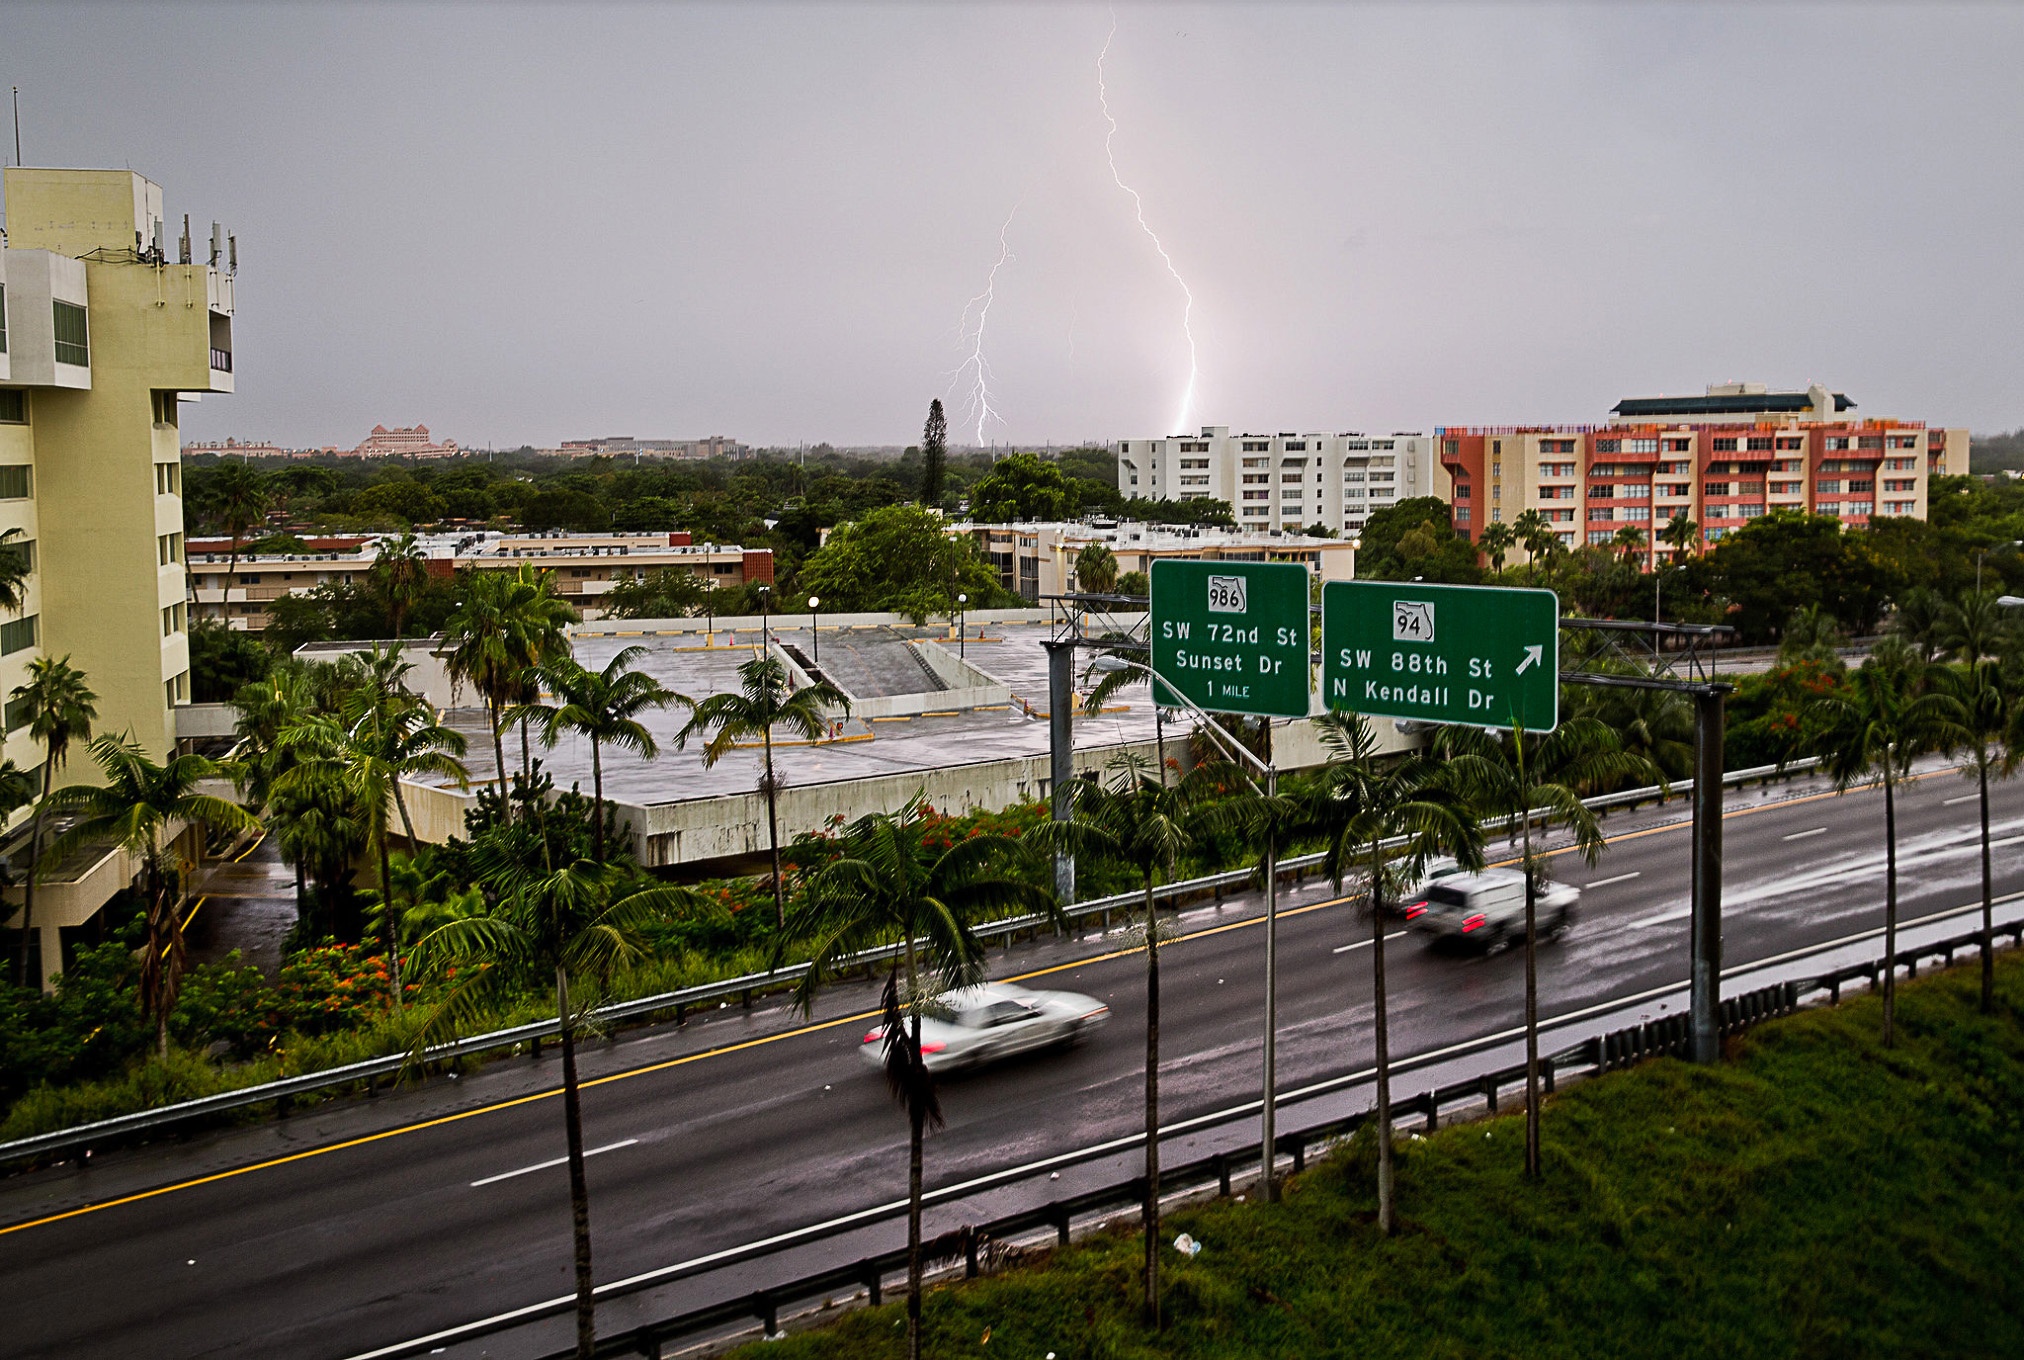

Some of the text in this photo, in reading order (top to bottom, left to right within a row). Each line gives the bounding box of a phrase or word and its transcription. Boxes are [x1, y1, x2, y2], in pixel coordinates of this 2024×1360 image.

[1210, 589, 1239, 607] 986
[1163, 621, 1297, 647] SW 72nd St
[1397, 615, 1420, 635] 94
[1176, 650, 1282, 674] Sunset Dr
[1340, 648, 1492, 678] SW 88th St
[1207, 680, 1250, 698] 1 MILE
[1334, 678, 1494, 710] N Kendall Dr
